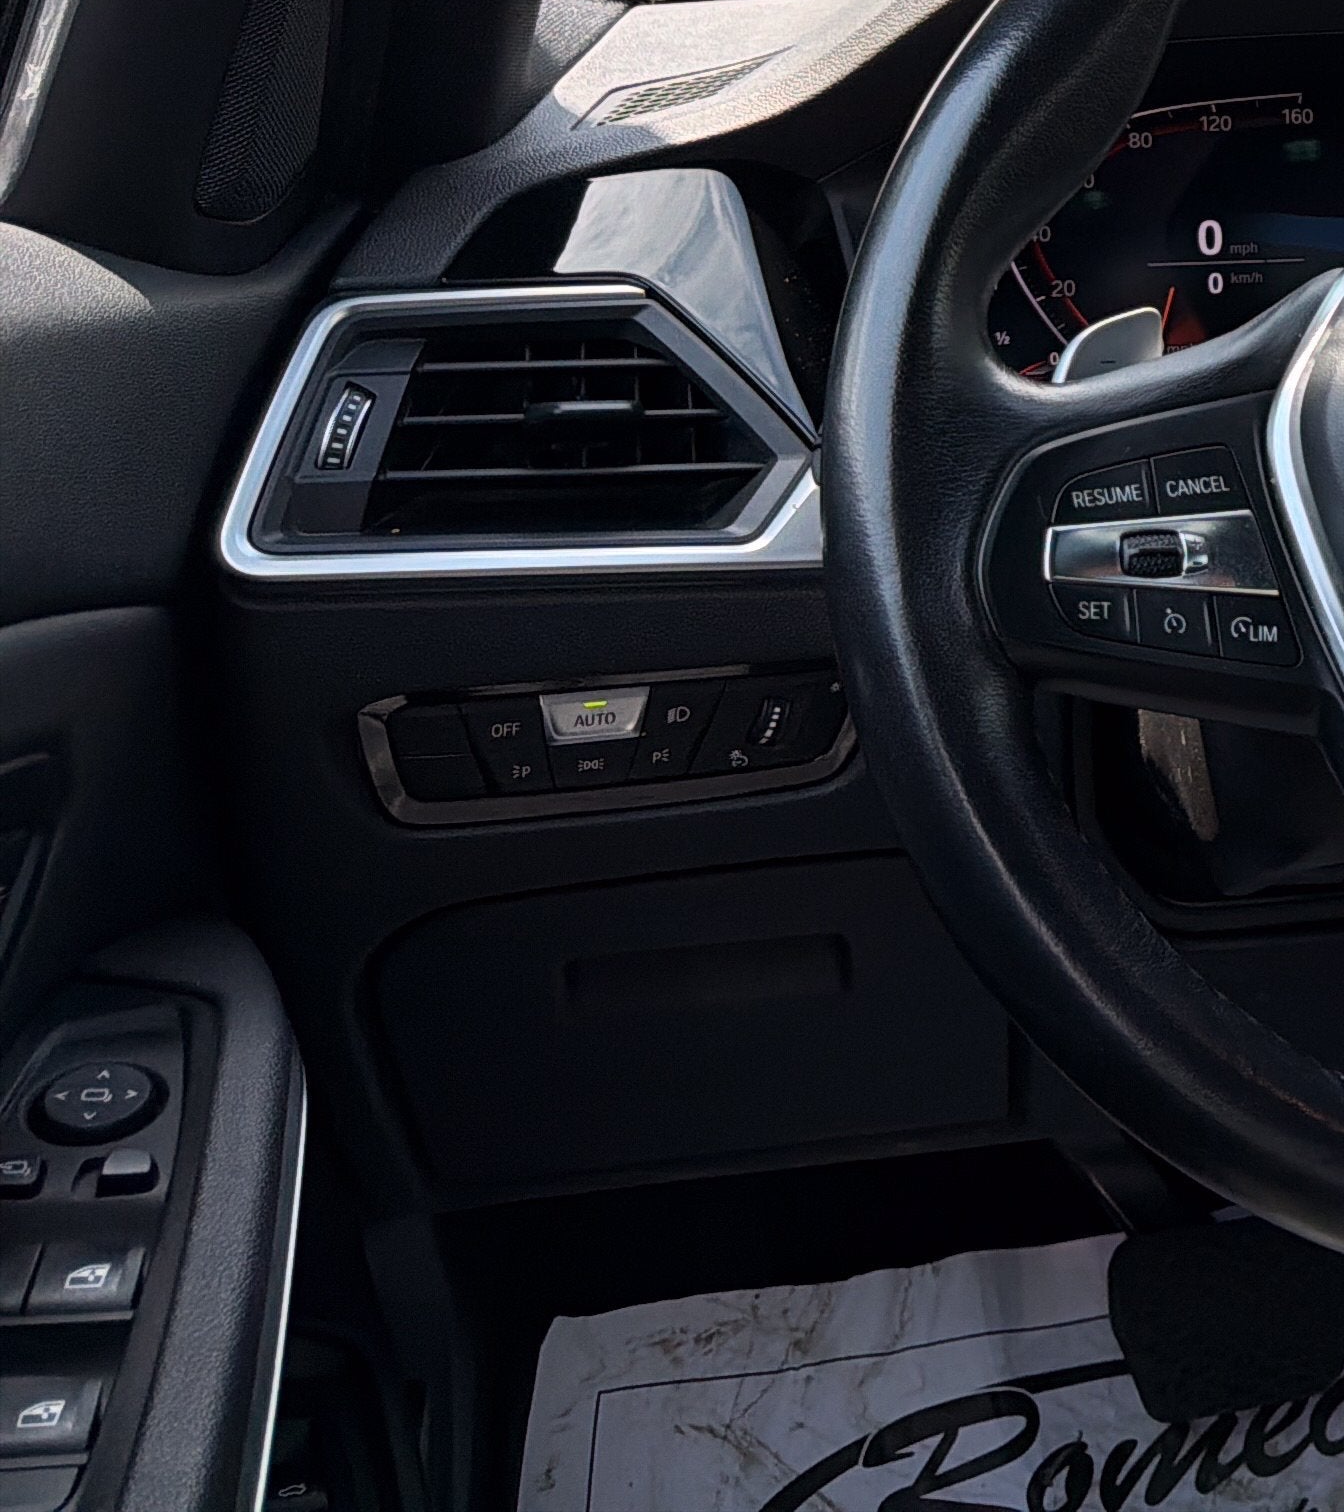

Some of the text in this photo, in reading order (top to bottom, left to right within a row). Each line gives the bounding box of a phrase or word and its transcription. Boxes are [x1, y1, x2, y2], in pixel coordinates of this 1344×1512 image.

[1199, 115, 1232, 132] 120
[1281, 108, 1314, 125] 160
[1128, 132, 1153, 148] 80
[1198, 219, 1258, 256] 0 mph
[1050, 279, 1076, 297] 20
[1207, 271, 1264, 295] 0 km/h
[1049, 351, 1059, 366] 0
[1166, 475, 1230, 497] CANCEL
[1072, 483, 1142, 508] RESUME
[1078, 602, 1112, 620] SET
[1249, 626, 1278, 643] LIM
[573, 711, 617, 729] AUTO
[491, 722, 521, 738] OFF
